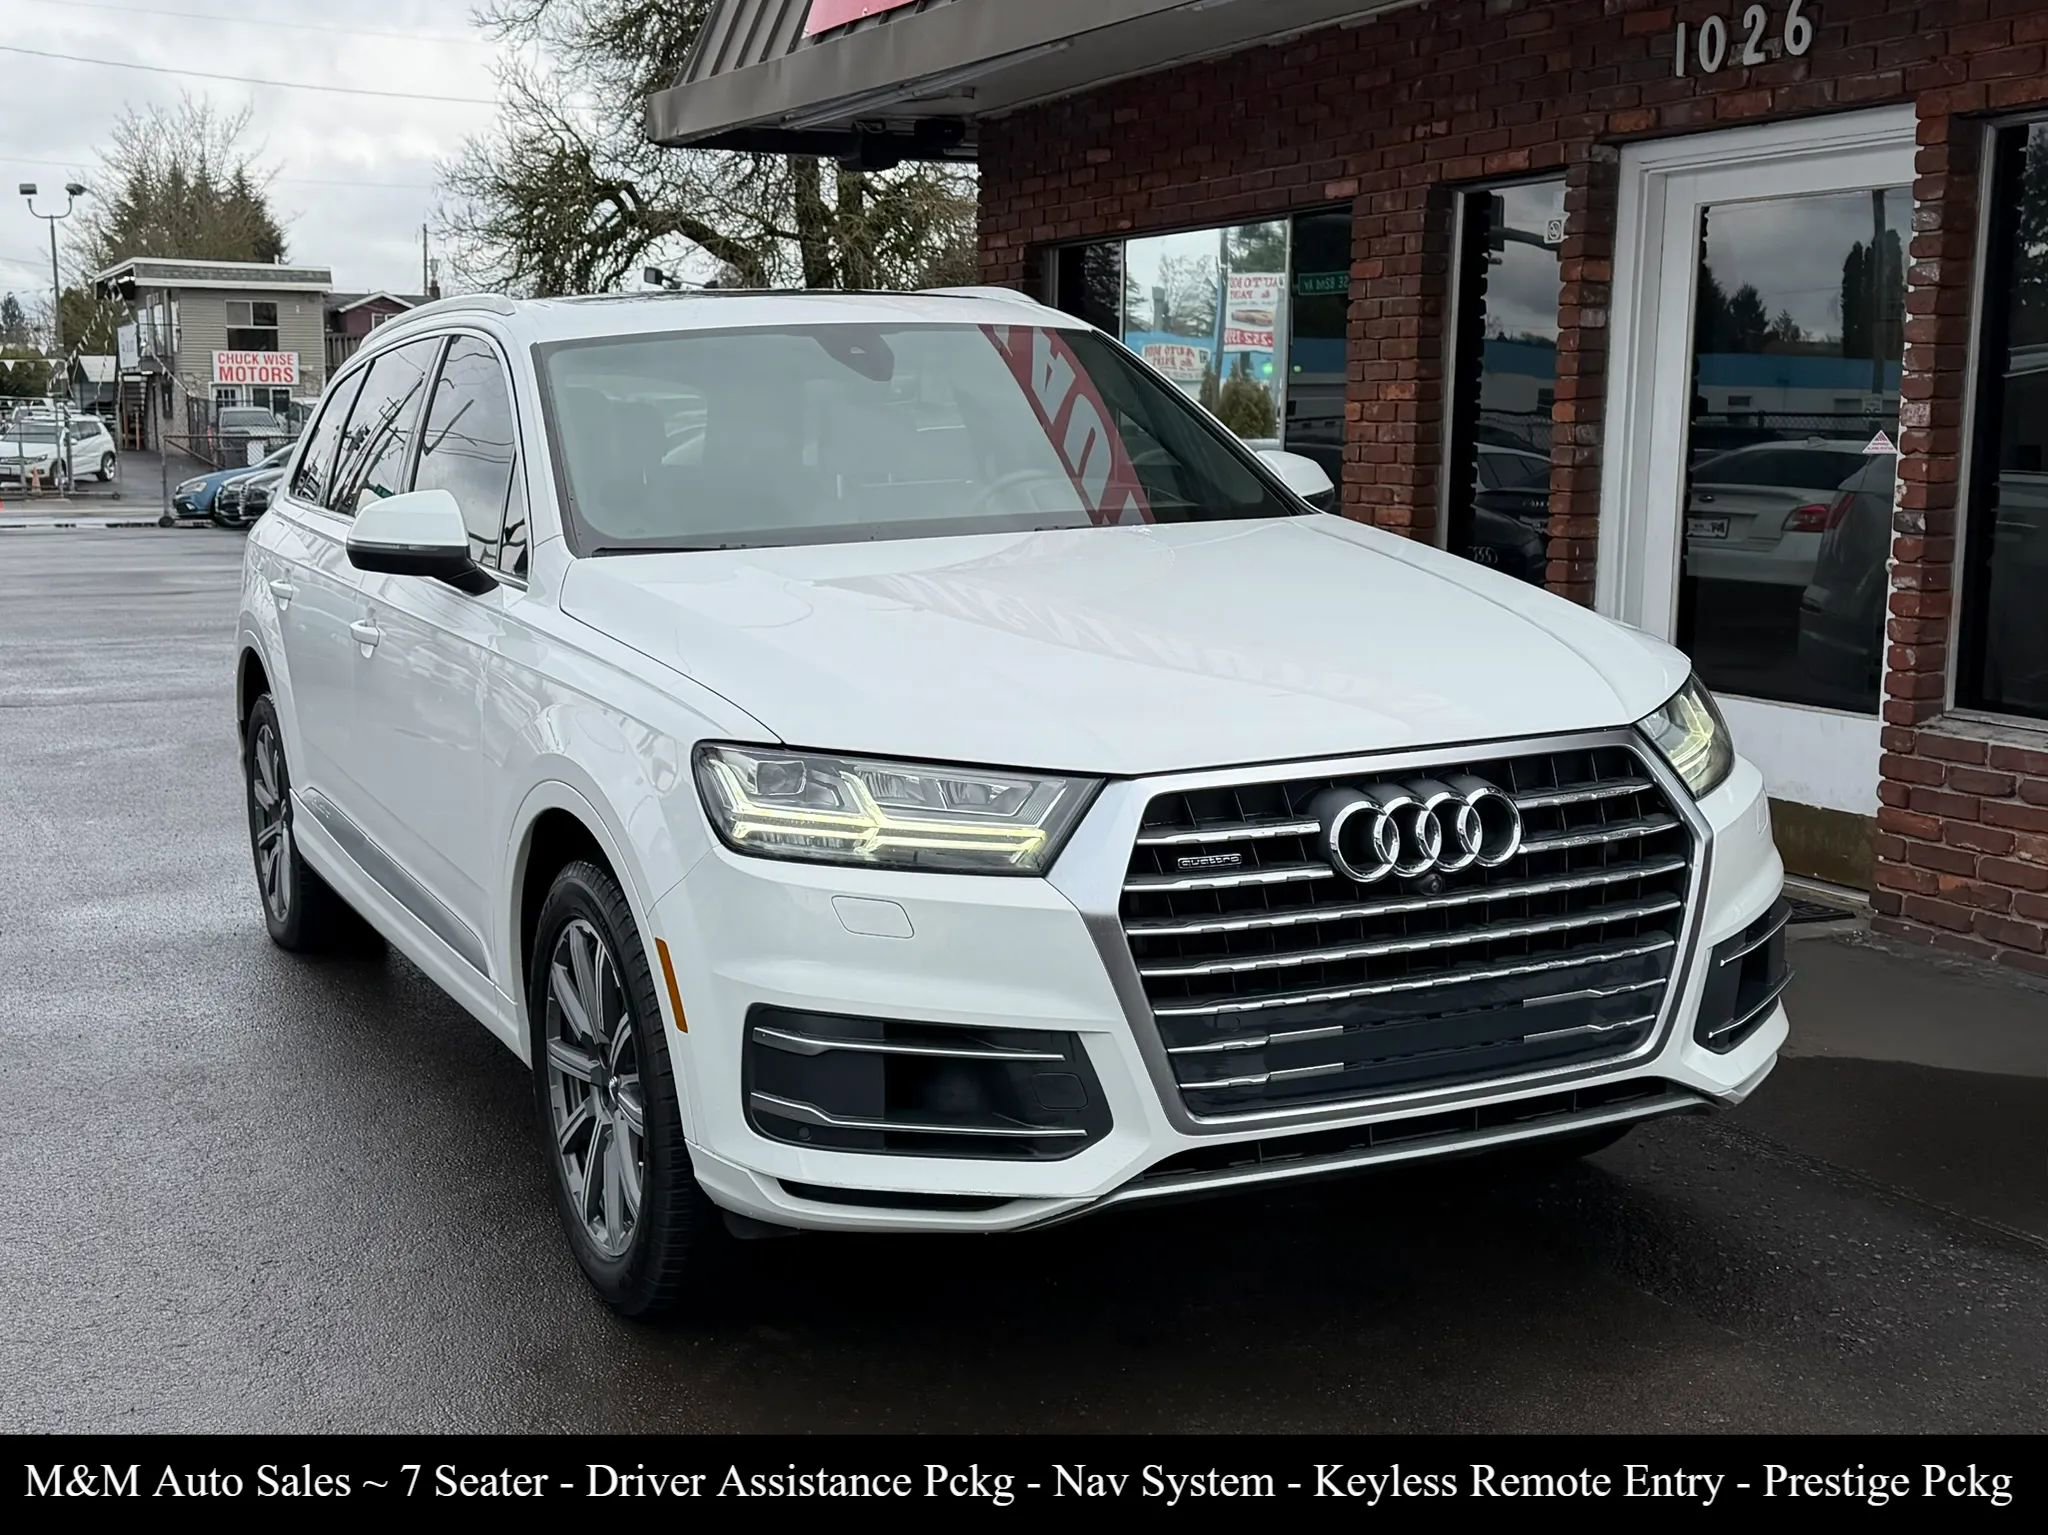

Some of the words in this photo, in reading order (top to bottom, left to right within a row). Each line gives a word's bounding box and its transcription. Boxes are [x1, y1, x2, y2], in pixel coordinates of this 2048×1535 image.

[1676, 0, 1812, 77] 1026
[218, 353, 259, 365] CHUCK
[263, 353, 294, 366] WISE
[219, 366, 294, 383] MOTORS
[1180, 855, 1240, 867] quattro
